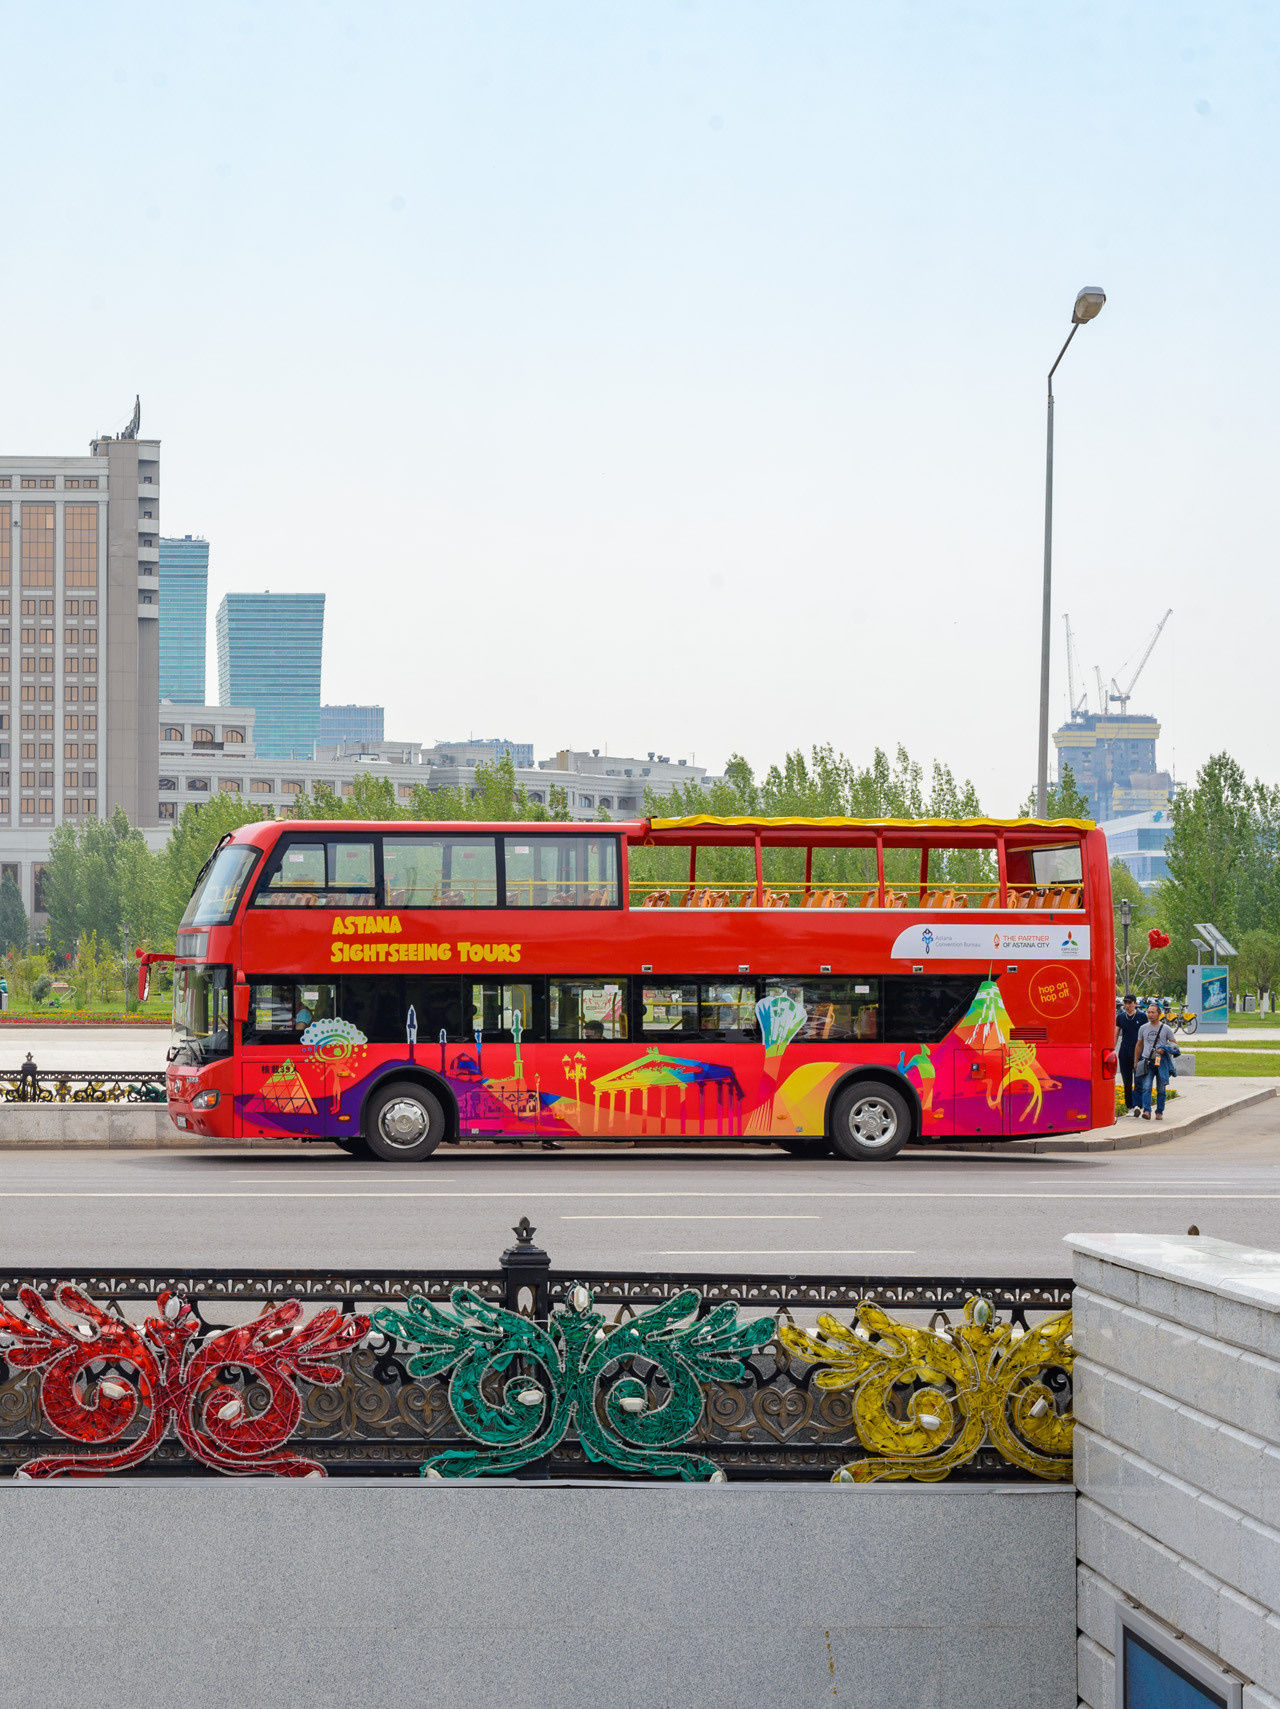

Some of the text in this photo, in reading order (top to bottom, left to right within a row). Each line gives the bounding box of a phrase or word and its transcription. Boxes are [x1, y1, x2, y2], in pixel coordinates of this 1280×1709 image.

[332, 916, 402, 935] ASTANA
[331, 941, 521, 963] SIGHTSEEING TOURS
[1039, 981, 1068, 994] hop on
[1040, 988, 1070, 1003] hop off
